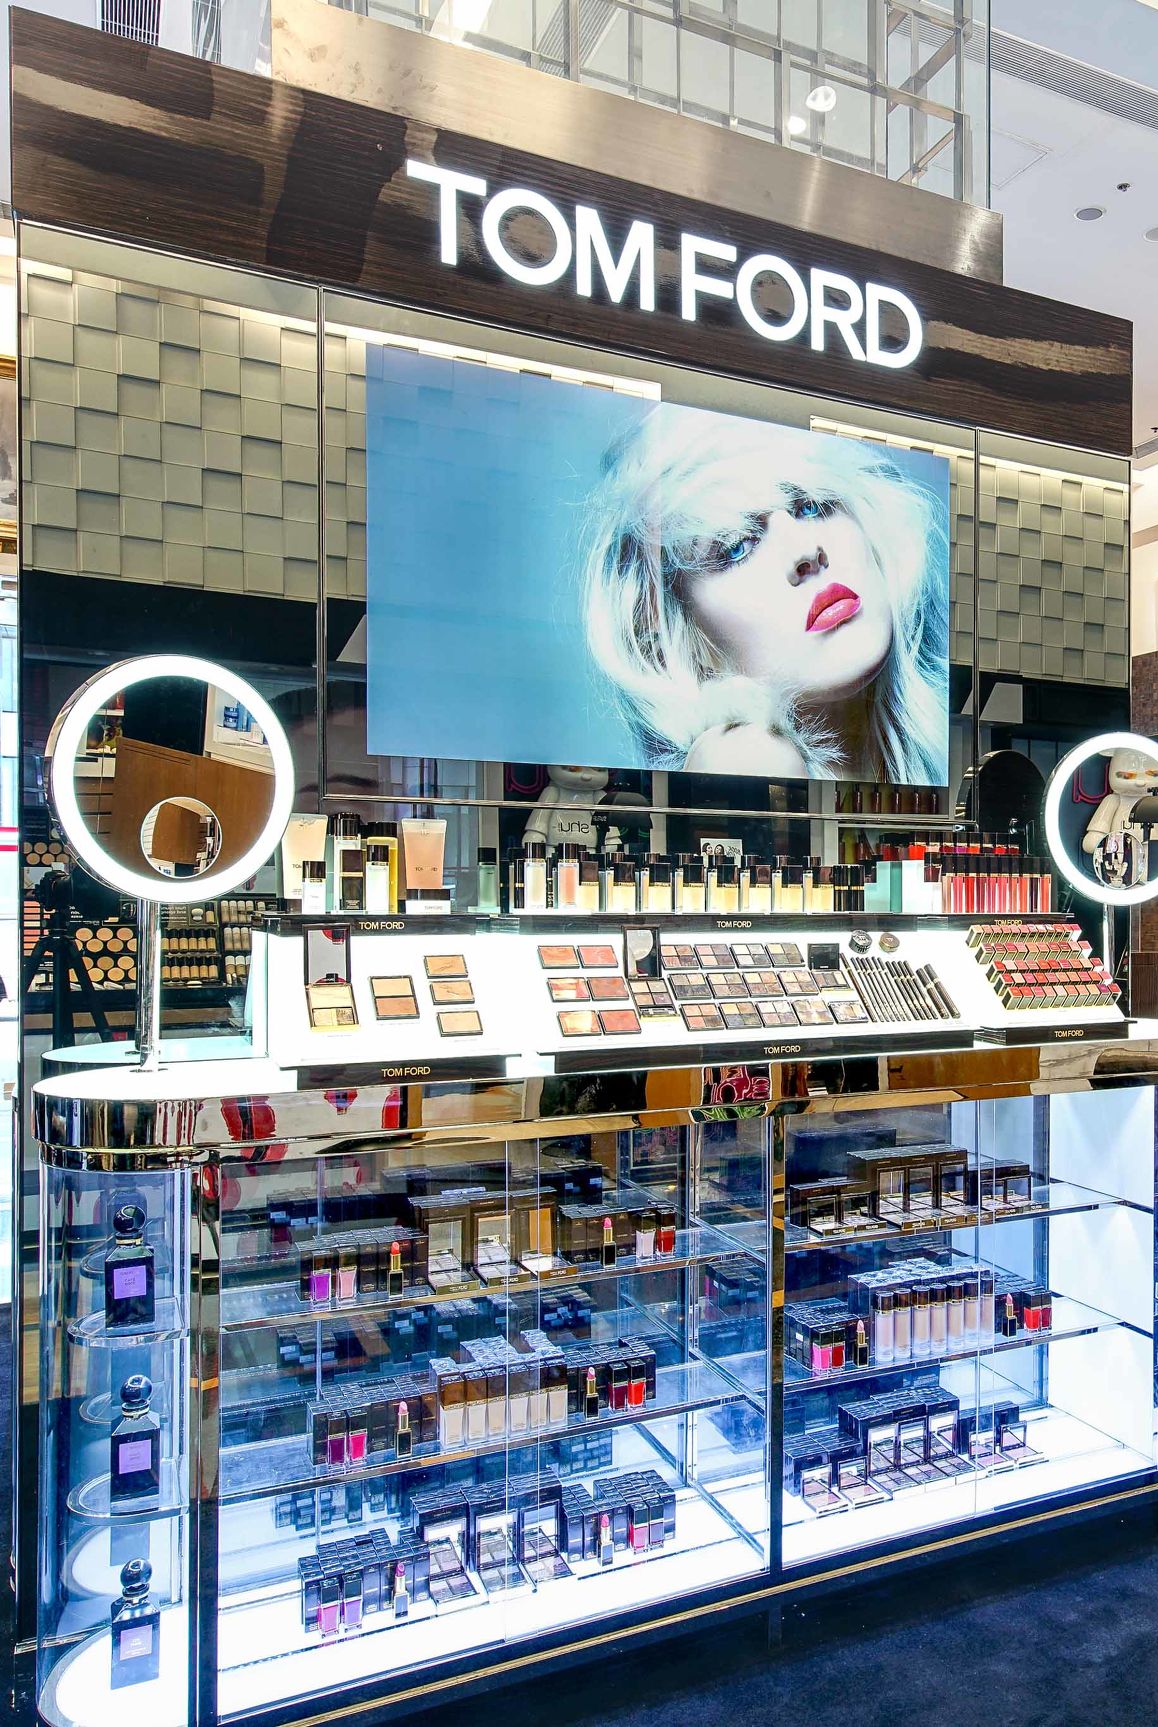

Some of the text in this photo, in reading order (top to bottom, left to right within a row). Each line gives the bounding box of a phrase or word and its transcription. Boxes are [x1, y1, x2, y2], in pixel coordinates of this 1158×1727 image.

[407, 159, 925, 369] TOM FORD
[359, 921, 405, 930] TOM FORD
[716, 920, 752, 928] TOM FORD
[1054, 1029, 1084, 1038] TOM FORD
[763, 1045, 801, 1055] TOM FORD
[381, 1066, 431, 1078] TOM FORD
